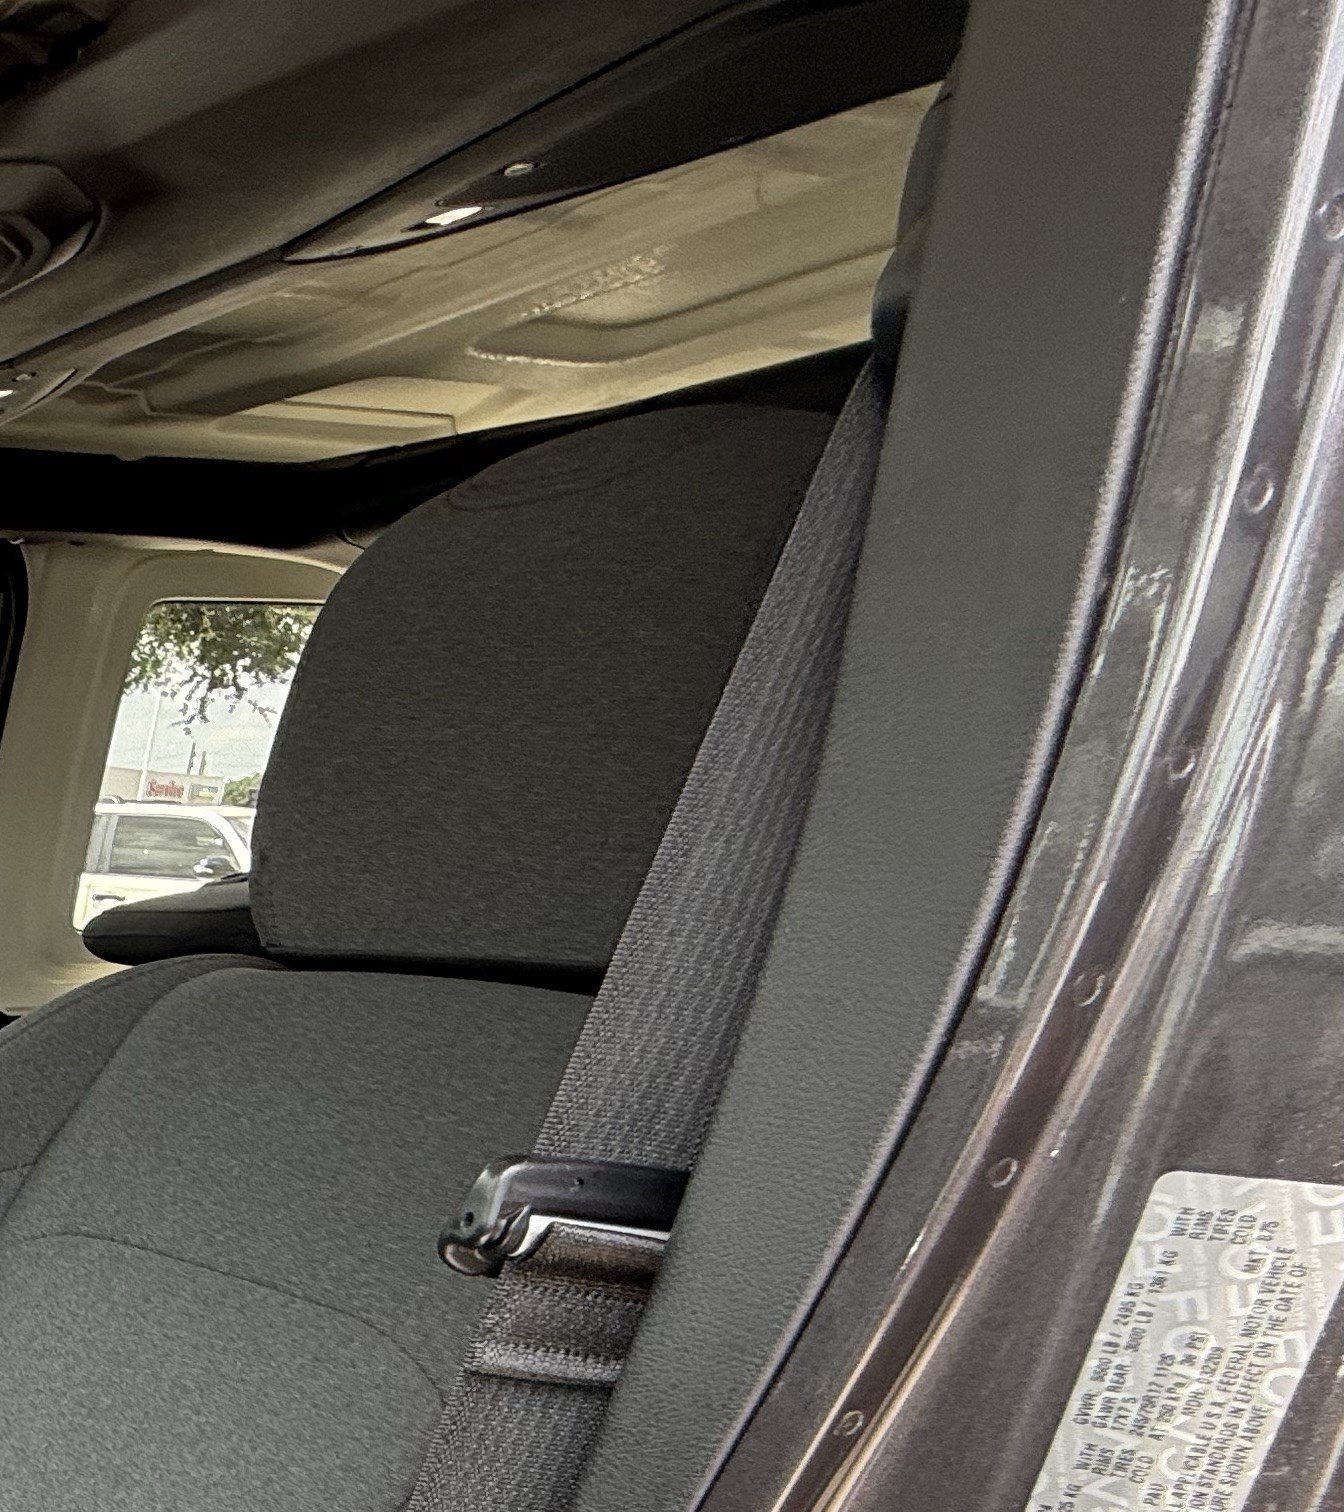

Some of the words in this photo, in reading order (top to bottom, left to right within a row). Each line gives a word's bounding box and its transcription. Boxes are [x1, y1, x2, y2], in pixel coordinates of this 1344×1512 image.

[1288, 1262, 1309, 1277] OF
[1273, 1282, 1300, 1311] DATE
[1262, 1315, 1285, 1337] THE
[1253, 1341, 1274, 1358] ON
[1171, 1434, 1209, 1498] APPLICABLE
[1217, 1342, 1250, 1391] FEDERAL
[1240, 1298, 1269, 1337] MOTOR
[1259, 1248, 1291, 1293] VEHICLE
[1234, 1362, 1264, 1402] EFFECT
[1227, 1406, 1245, 1418] IN
[1198, 1423, 1237, 1487] STANDARDS
[1220, 1445, 1250, 1485] SHOWN
[1240, 1406, 1268, 1441] ABOVE
